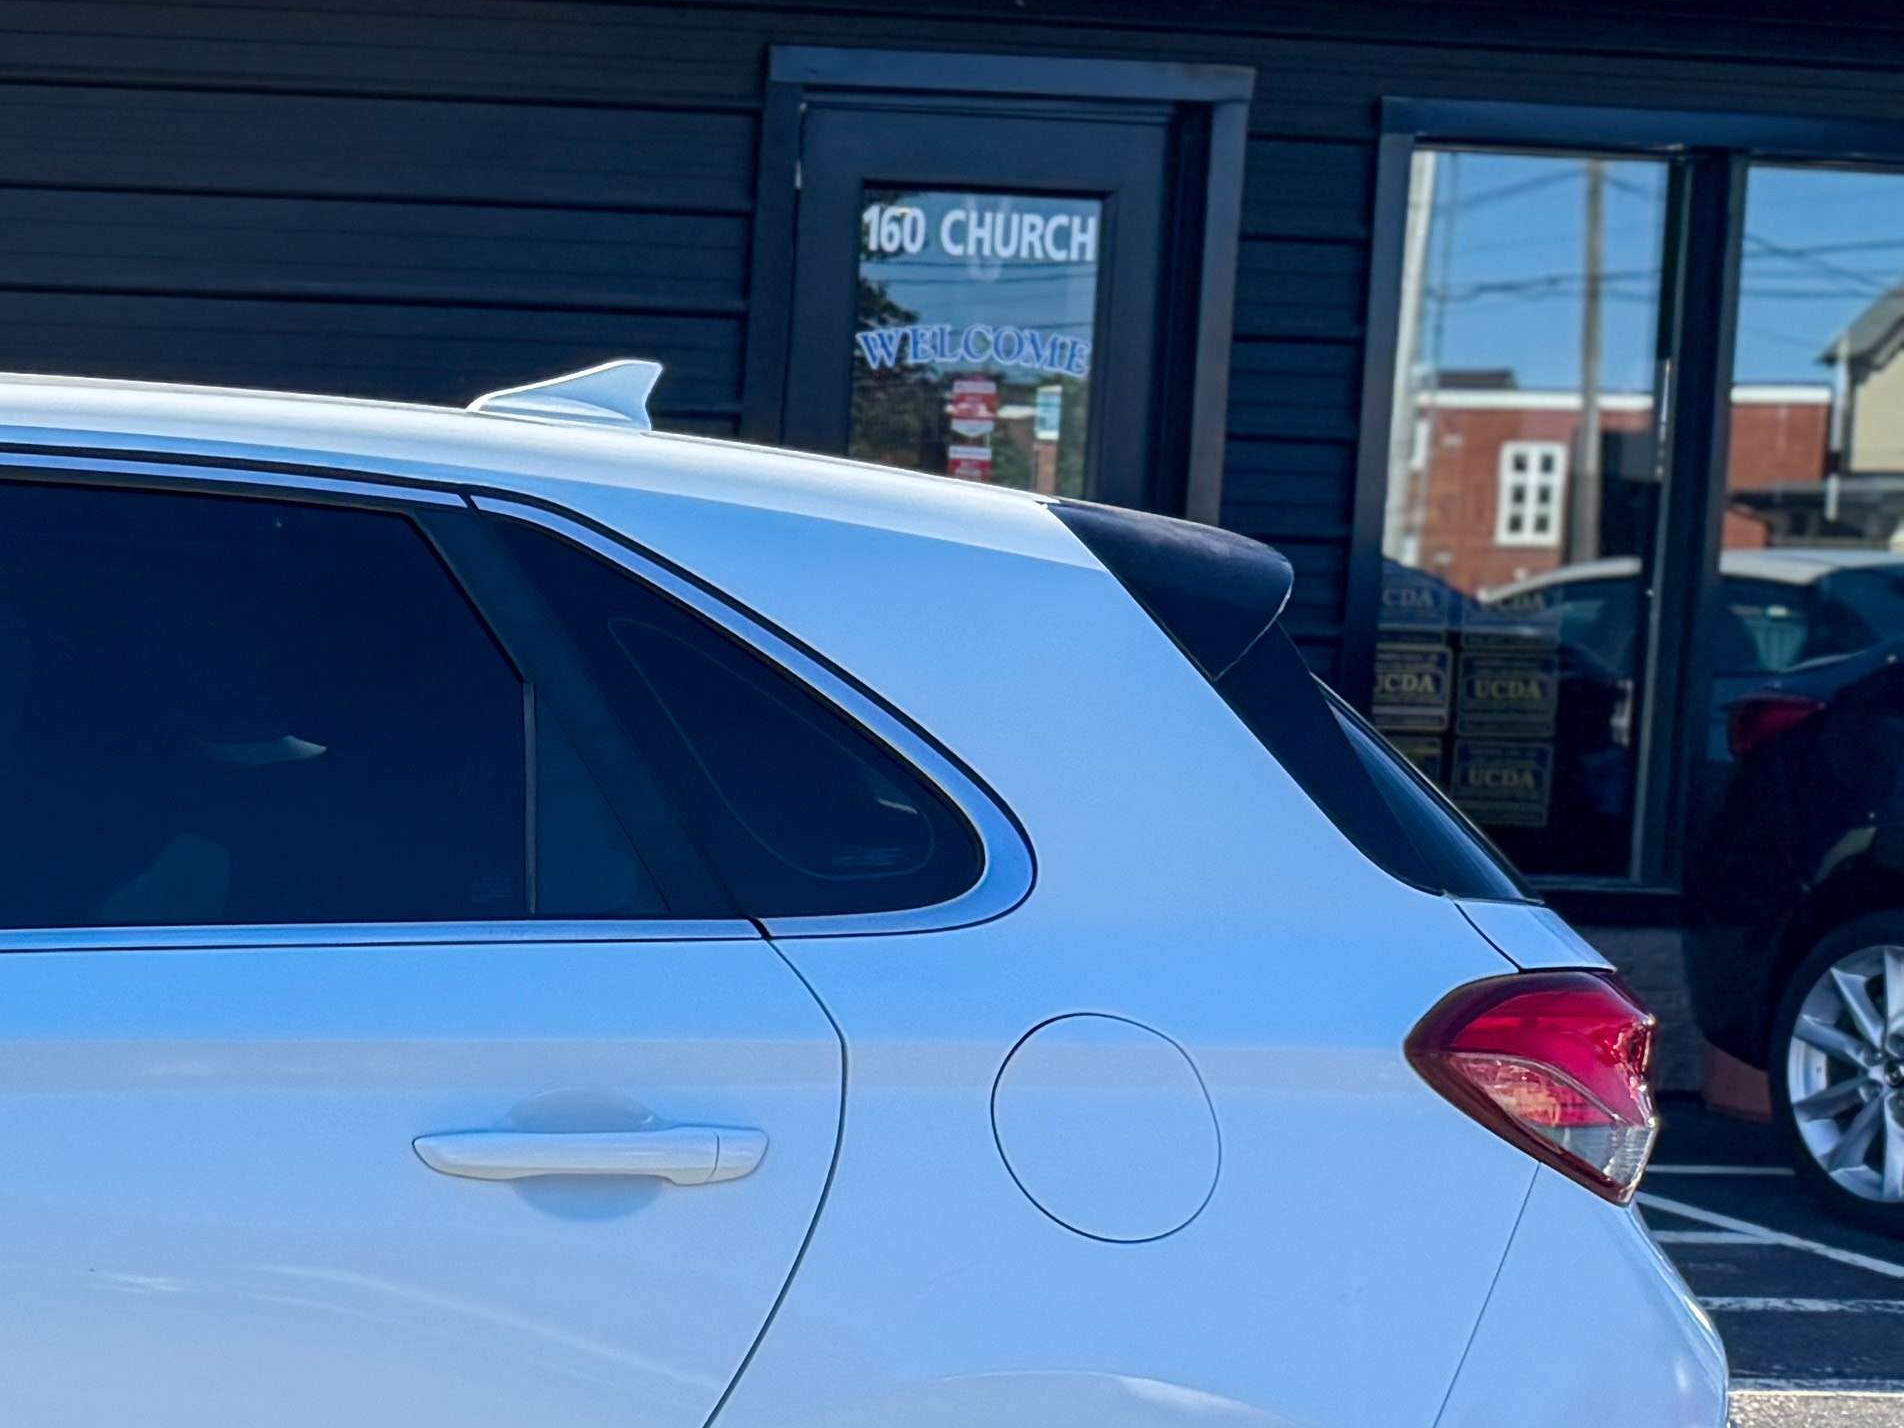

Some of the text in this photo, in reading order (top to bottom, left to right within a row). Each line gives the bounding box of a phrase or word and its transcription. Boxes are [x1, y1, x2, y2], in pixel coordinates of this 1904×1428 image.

[862, 204, 1097, 262] 160 CHURCH
[856, 324, 1091, 377] WELCOME
[1381, 587, 1434, 608] CDA
[1474, 678, 1542, 700] UCDA
[1467, 764, 1536, 789] UCDA
